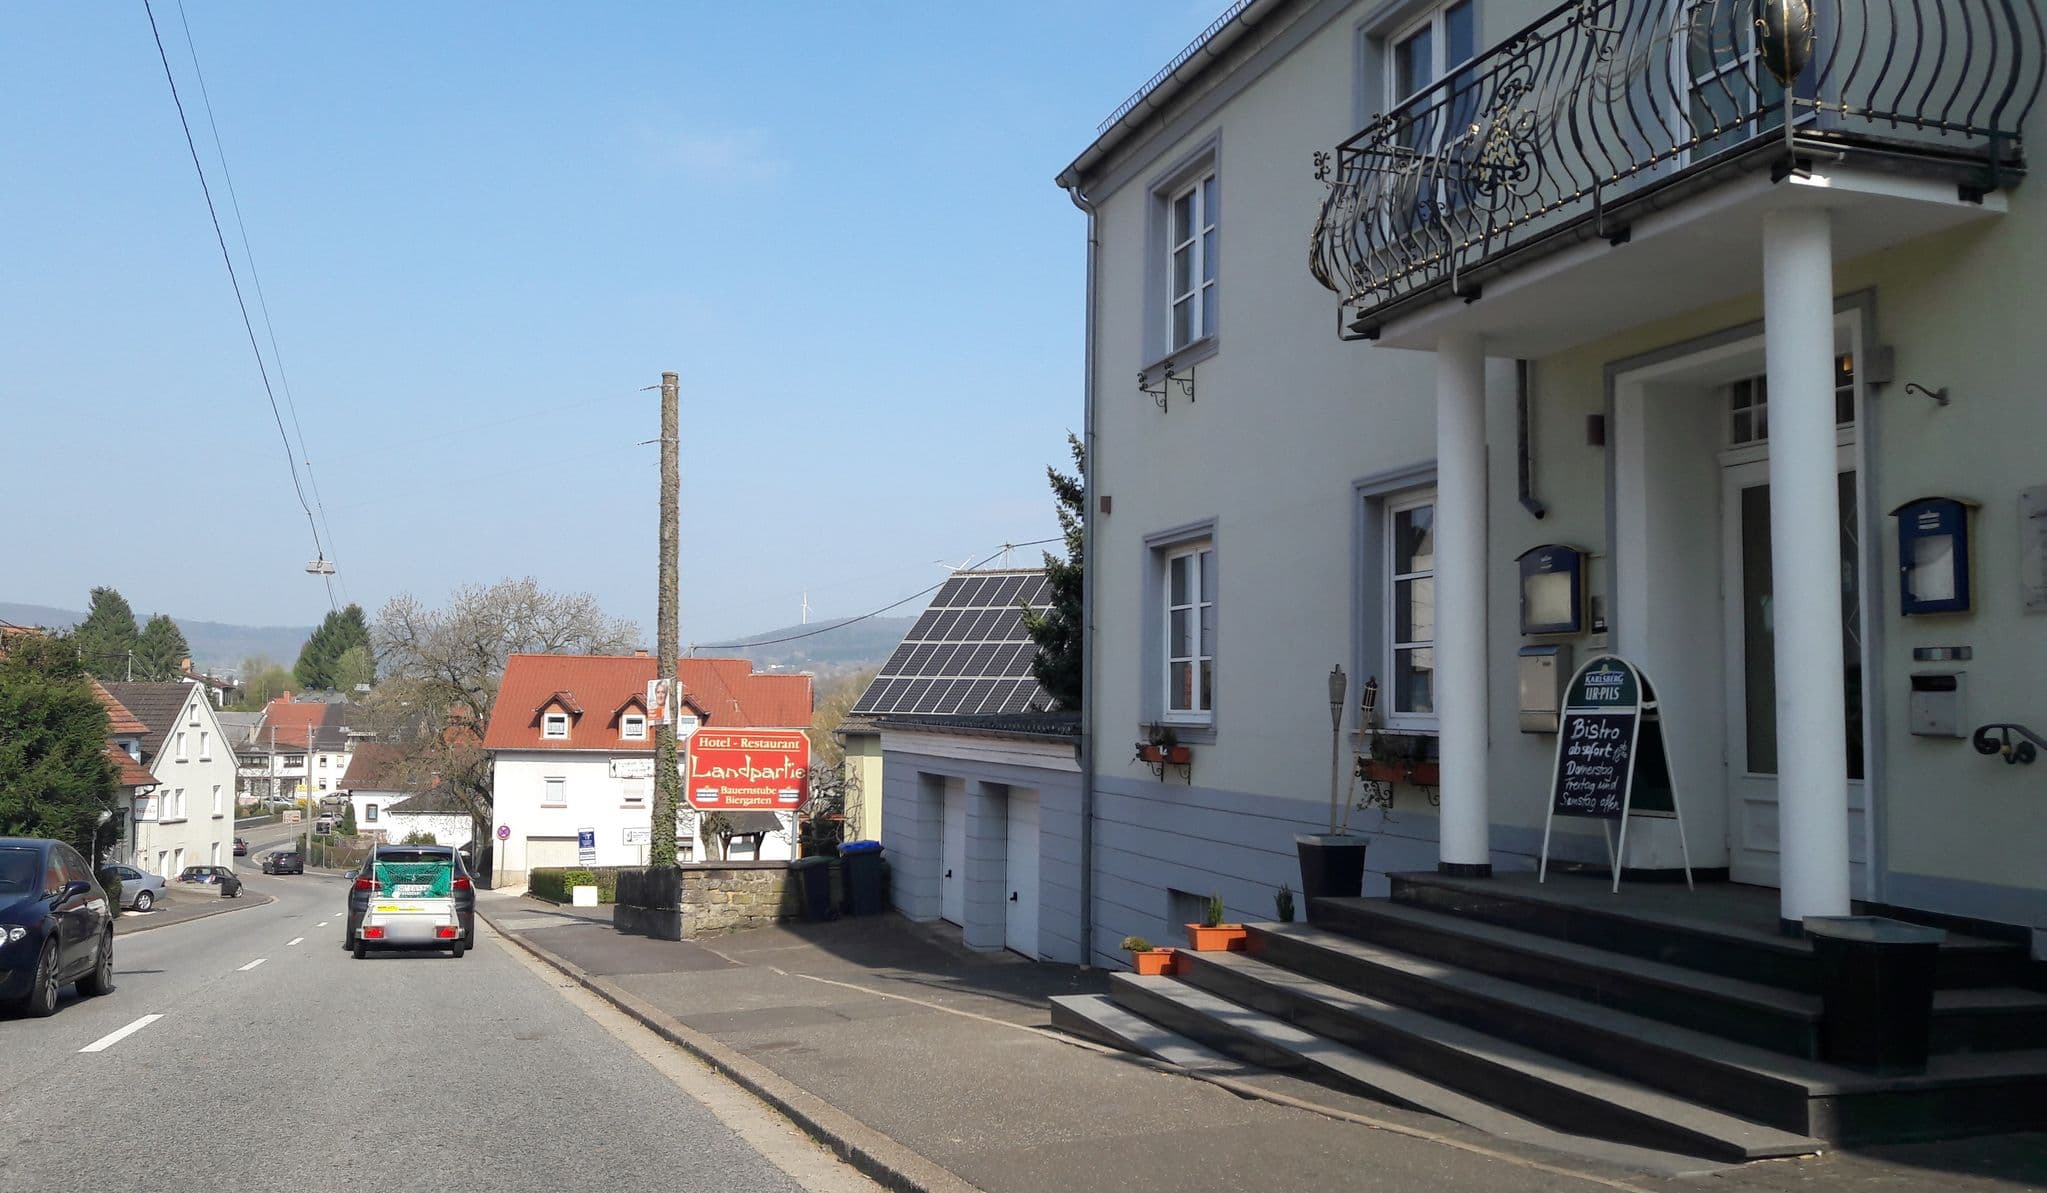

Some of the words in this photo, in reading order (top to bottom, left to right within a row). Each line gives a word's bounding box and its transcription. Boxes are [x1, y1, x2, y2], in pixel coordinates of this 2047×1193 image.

[1585, 675, 1624, 684] KARLSBERG
[1571, 718, 1620, 739] Bistro
[699, 737, 731, 747] Hotel
[741, 738, 800, 749] Restaurant
[691, 754, 806, 782] Landpartie
[721, 786, 777, 795] Bauernstube
[1565, 777, 1595, 795] Freitag
[1598, 776, 1619, 790] und
[725, 796, 772, 806] Biergarten
[1560, 792, 1597, 812] Samstag
